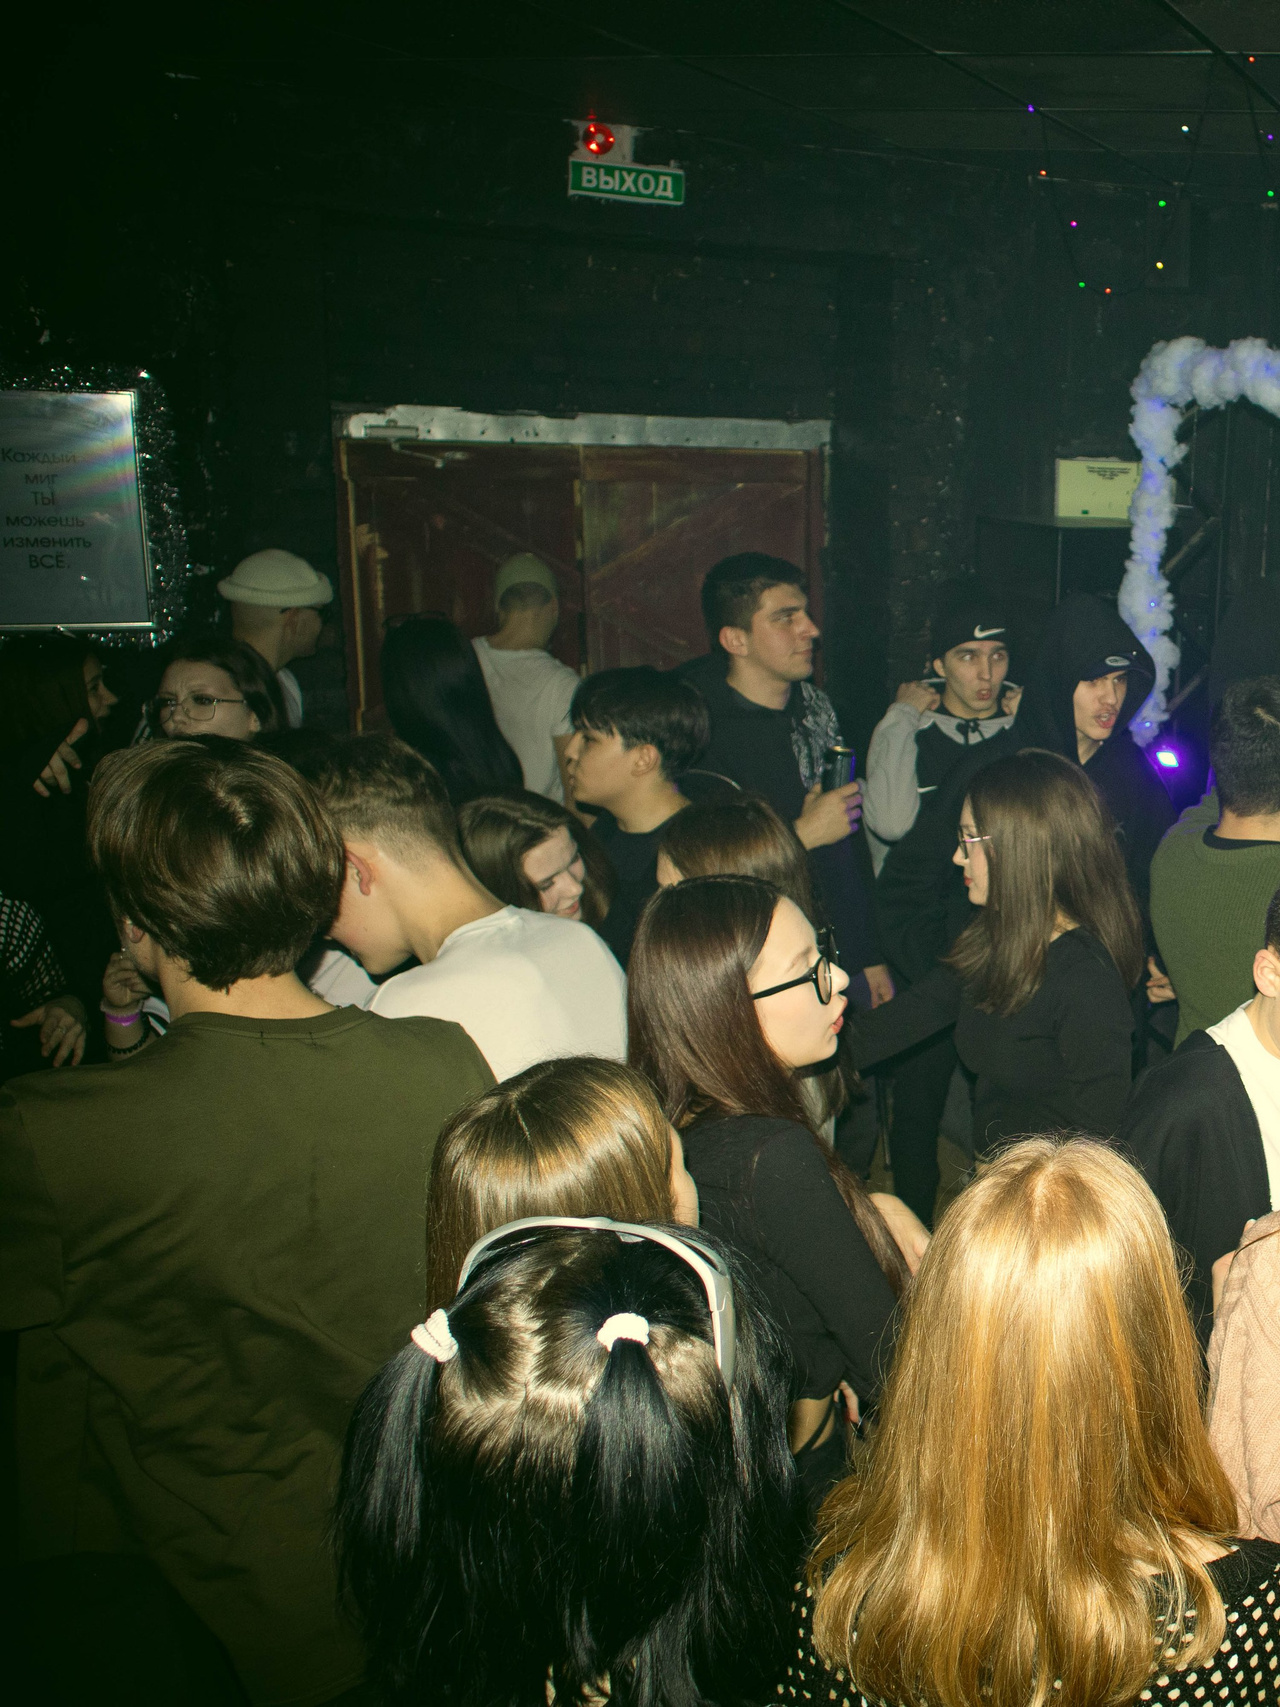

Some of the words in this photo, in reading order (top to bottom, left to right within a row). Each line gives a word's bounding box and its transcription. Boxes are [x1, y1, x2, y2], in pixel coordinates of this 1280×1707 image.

[581, 166, 674, 199] ВЫХОД
[1, 448, 77, 464] Каждый
[25, 473, 58, 485] миг
[30, 491, 56, 506] ТЫ
[5, 515, 85, 528] можешь
[3, 536, 92, 548] изменить
[28, 551, 71, 569] ВСЁ.
